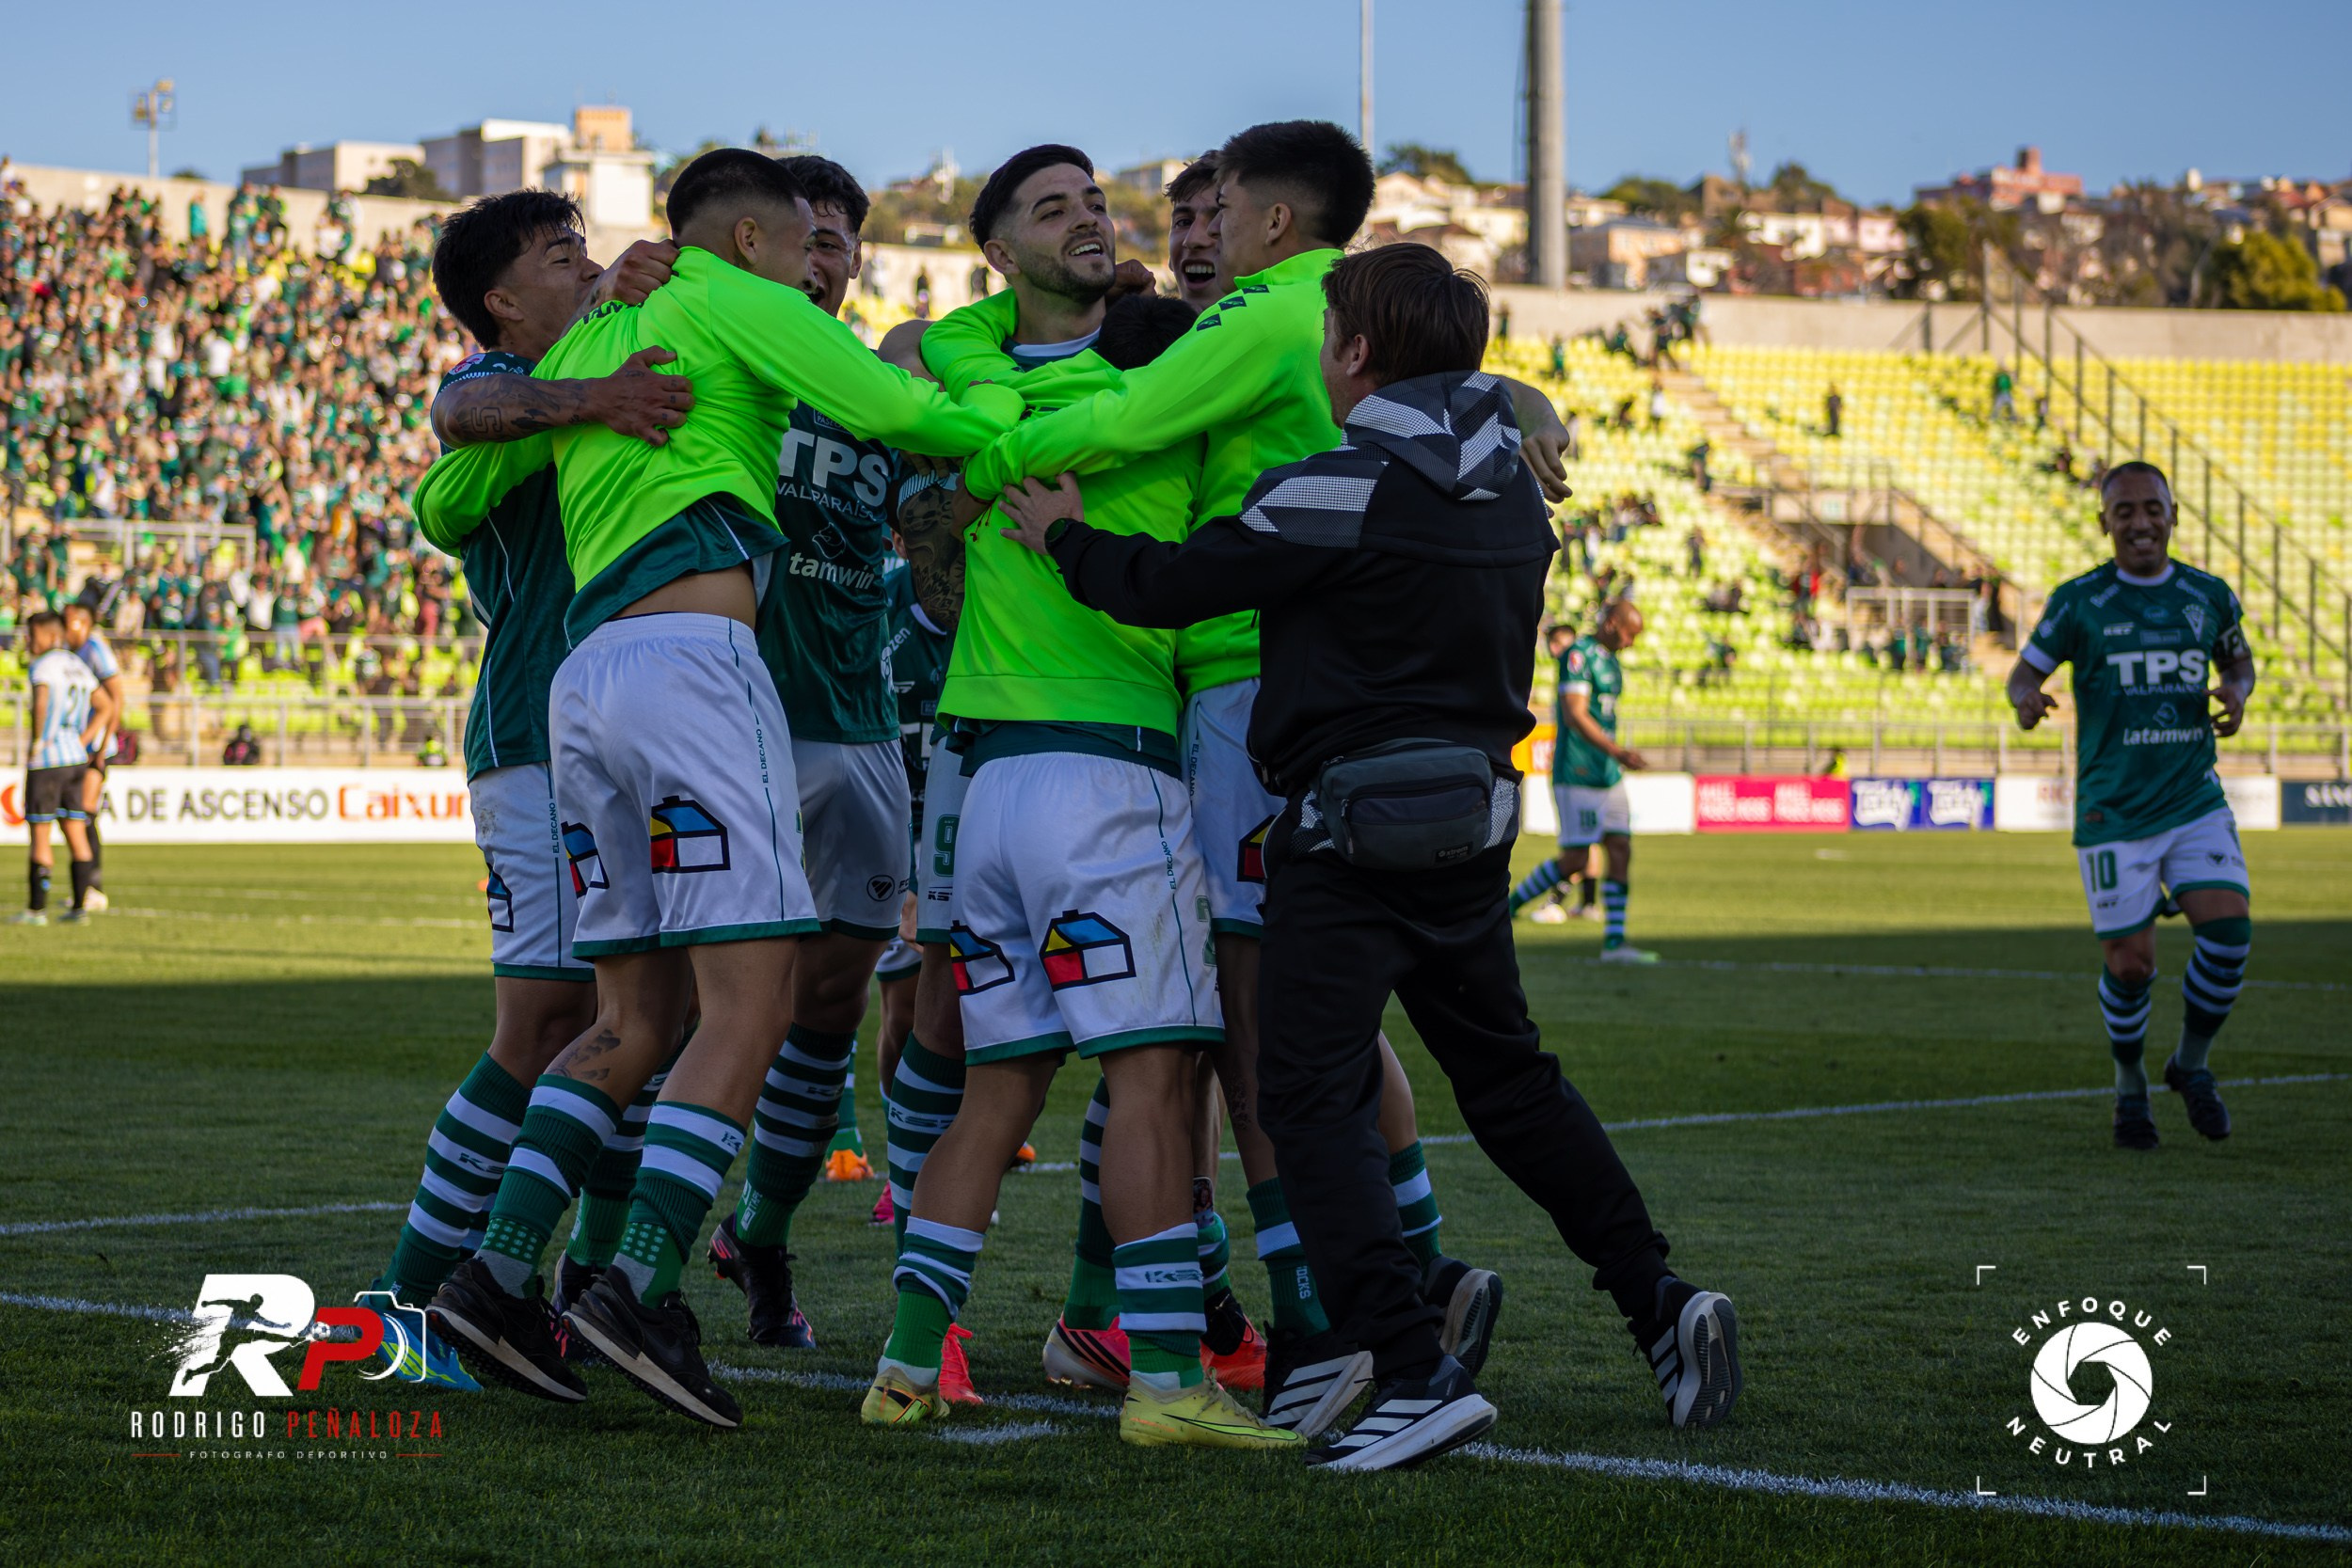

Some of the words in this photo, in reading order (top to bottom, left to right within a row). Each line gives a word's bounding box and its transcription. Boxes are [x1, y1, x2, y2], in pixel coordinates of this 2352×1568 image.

[779, 427, 889, 507] TPS
[788, 552, 875, 590] tamwin
[2106, 648, 2208, 687] TPS
[755, 728, 768, 770] DECANO
[2122, 726, 2204, 746] Latamwin
[763, 770, 769, 784] EL
[125, 787, 167, 821] DE
[176, 787, 329, 821] ASCENSO
[549, 802, 559, 840] DECANO
[553, 840, 560, 854] EL
[933, 814, 961, 878] 9
[1161, 840, 1175, 878] DECANO
[2086, 849, 2117, 894] 10
[927, 890, 953, 901] KS
[1295, 1265, 1312, 1300] OCKS
